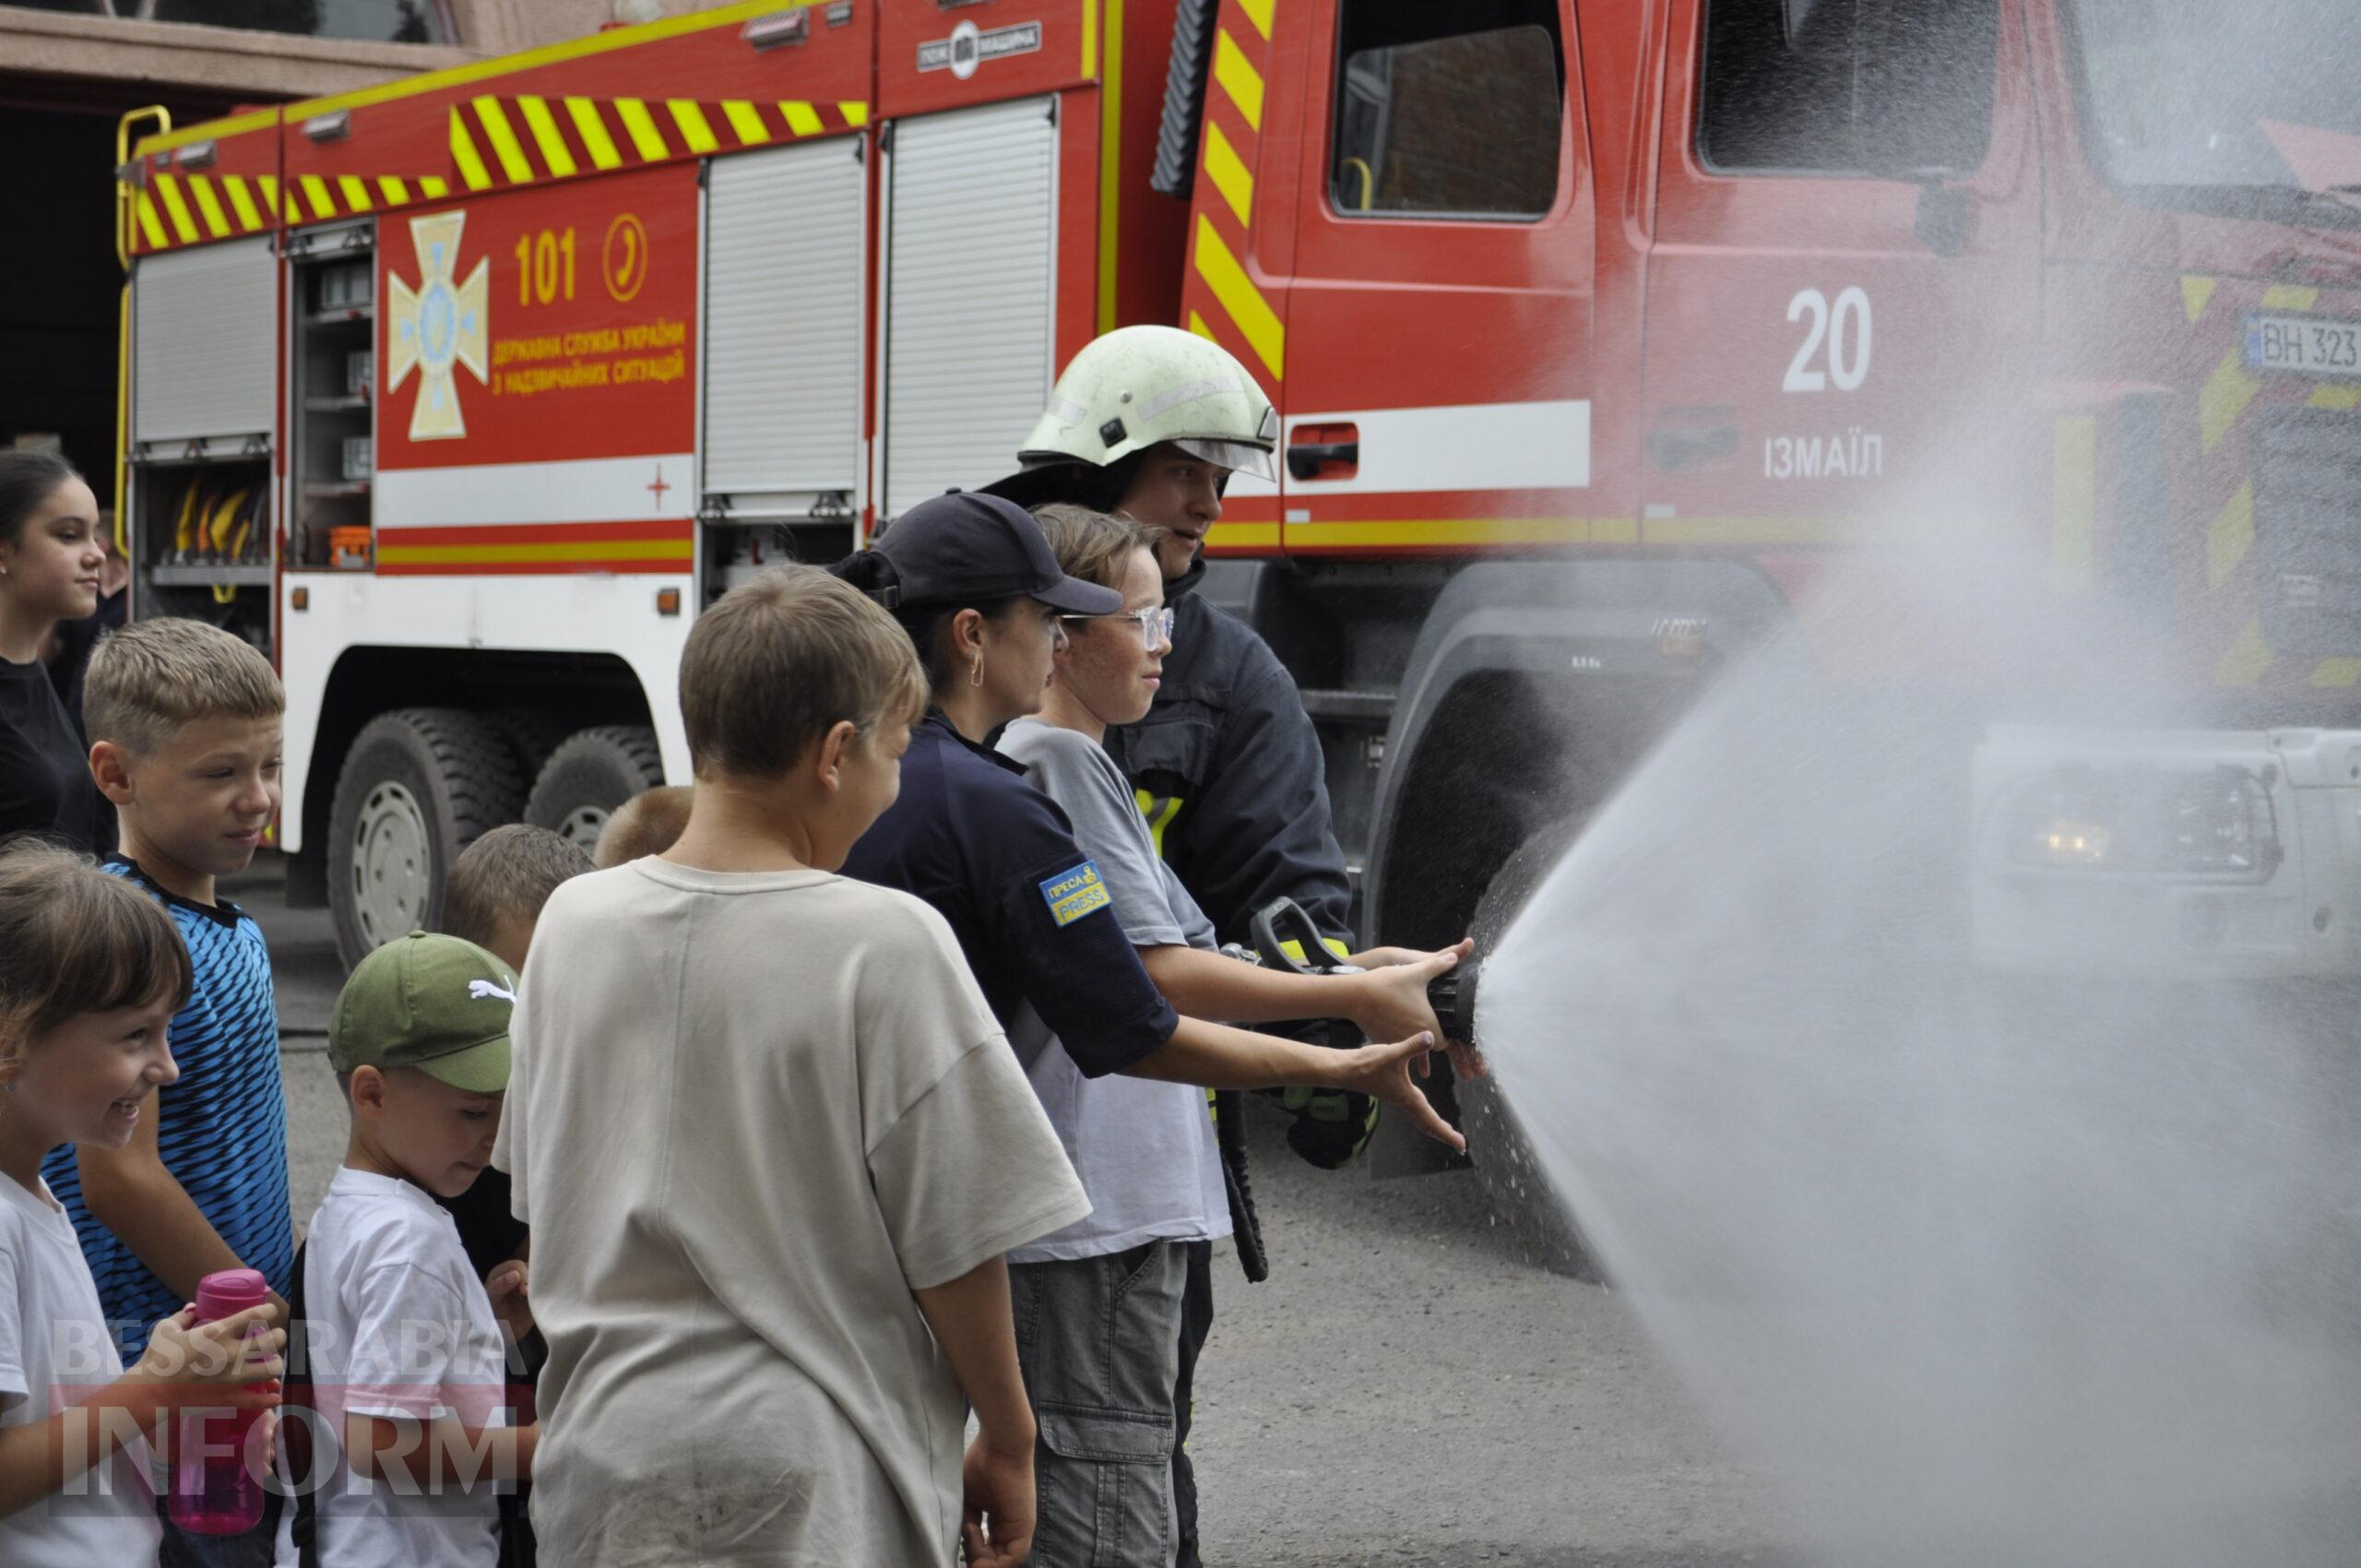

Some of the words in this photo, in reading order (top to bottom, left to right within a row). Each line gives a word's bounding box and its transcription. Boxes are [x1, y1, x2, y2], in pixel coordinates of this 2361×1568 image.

[516, 226, 575, 307] 101
[1782, 286, 1872, 393] 20
[1763, 426, 1883, 478] ІЗМАЇЛ
[1060, 888, 1104, 921] PRESS
